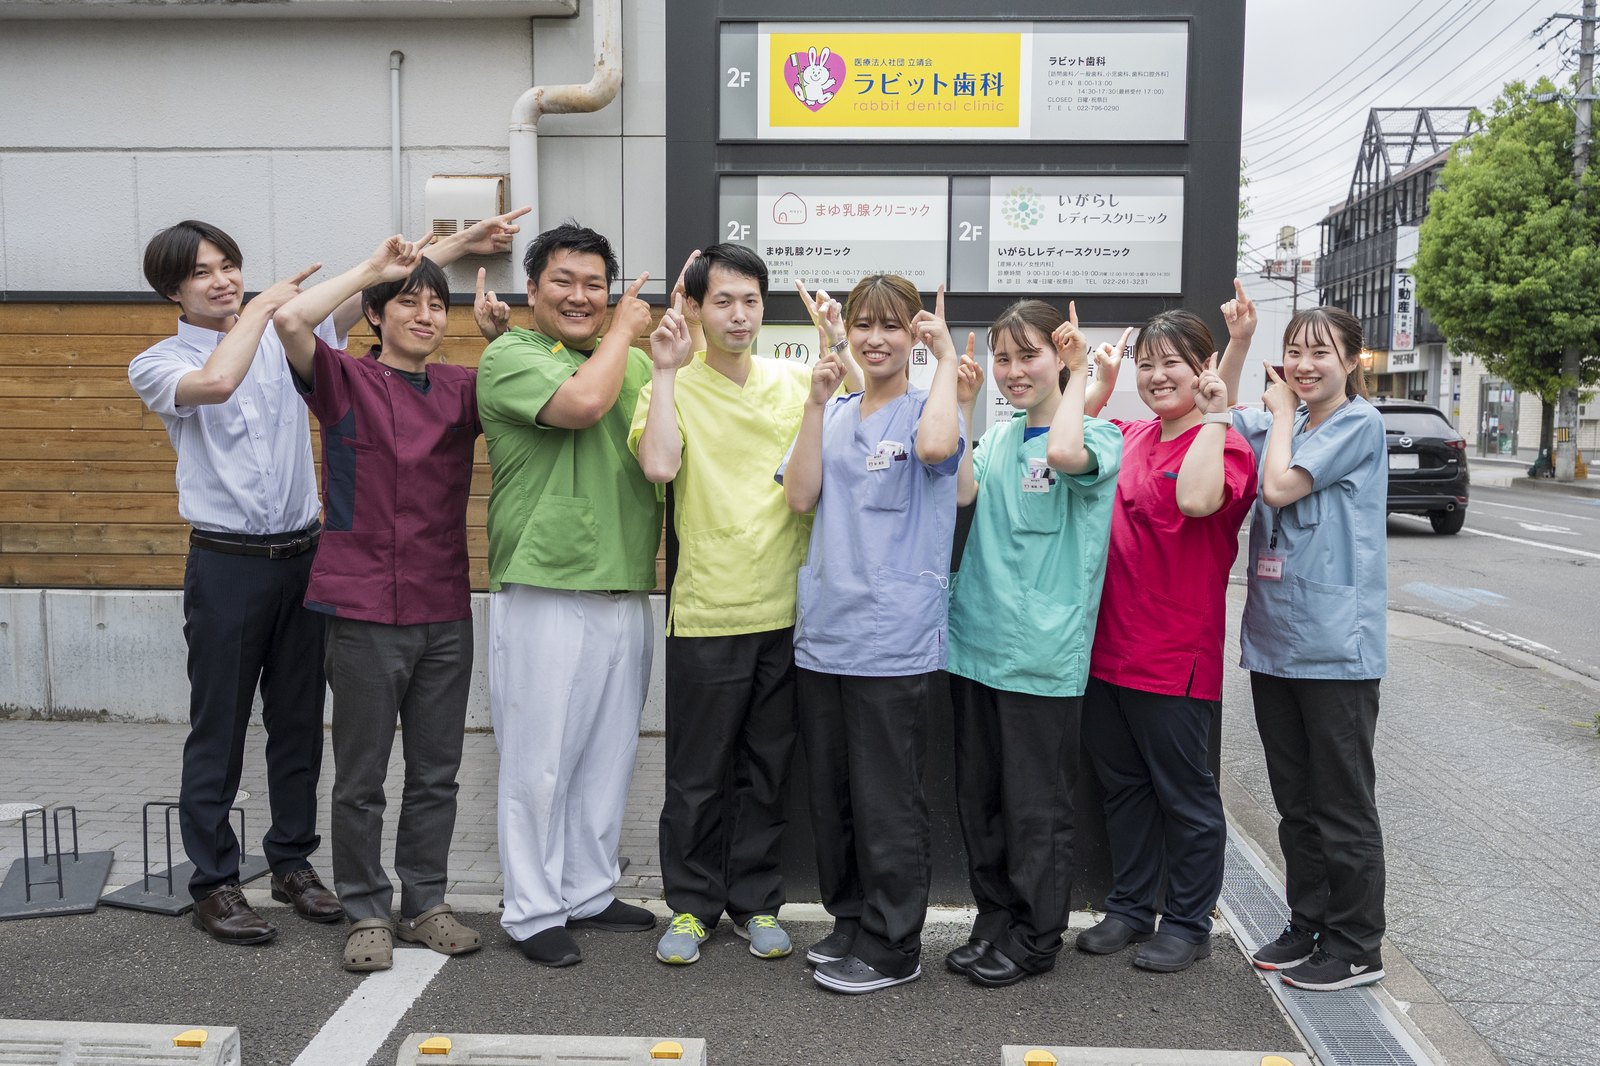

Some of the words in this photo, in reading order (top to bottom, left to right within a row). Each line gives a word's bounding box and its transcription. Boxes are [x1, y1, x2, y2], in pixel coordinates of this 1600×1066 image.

[854, 58, 905, 67] 医療法人社団
[1048, 56, 1106, 67] ラビット歯科
[727, 67, 751, 88] 2F
[854, 72, 1004, 96] ラビット歯科
[853, 100, 900, 111] rabbit
[906, 100, 957, 111] dental
[963, 100, 1004, 111] clinic
[1058, 193, 1120, 208] いがらし
[815, 203, 930, 217] まゆ乳腺クリニック
[1058, 212, 1168, 224] レディースクリニック
[727, 220, 751, 241] 2F
[959, 221, 983, 242] 2F
[766, 246, 851, 257] まゆ乳腺クリニック
[998, 247, 1131, 257] いがらしレディースクリニック
[1398, 275, 1411, 313] 不動産
